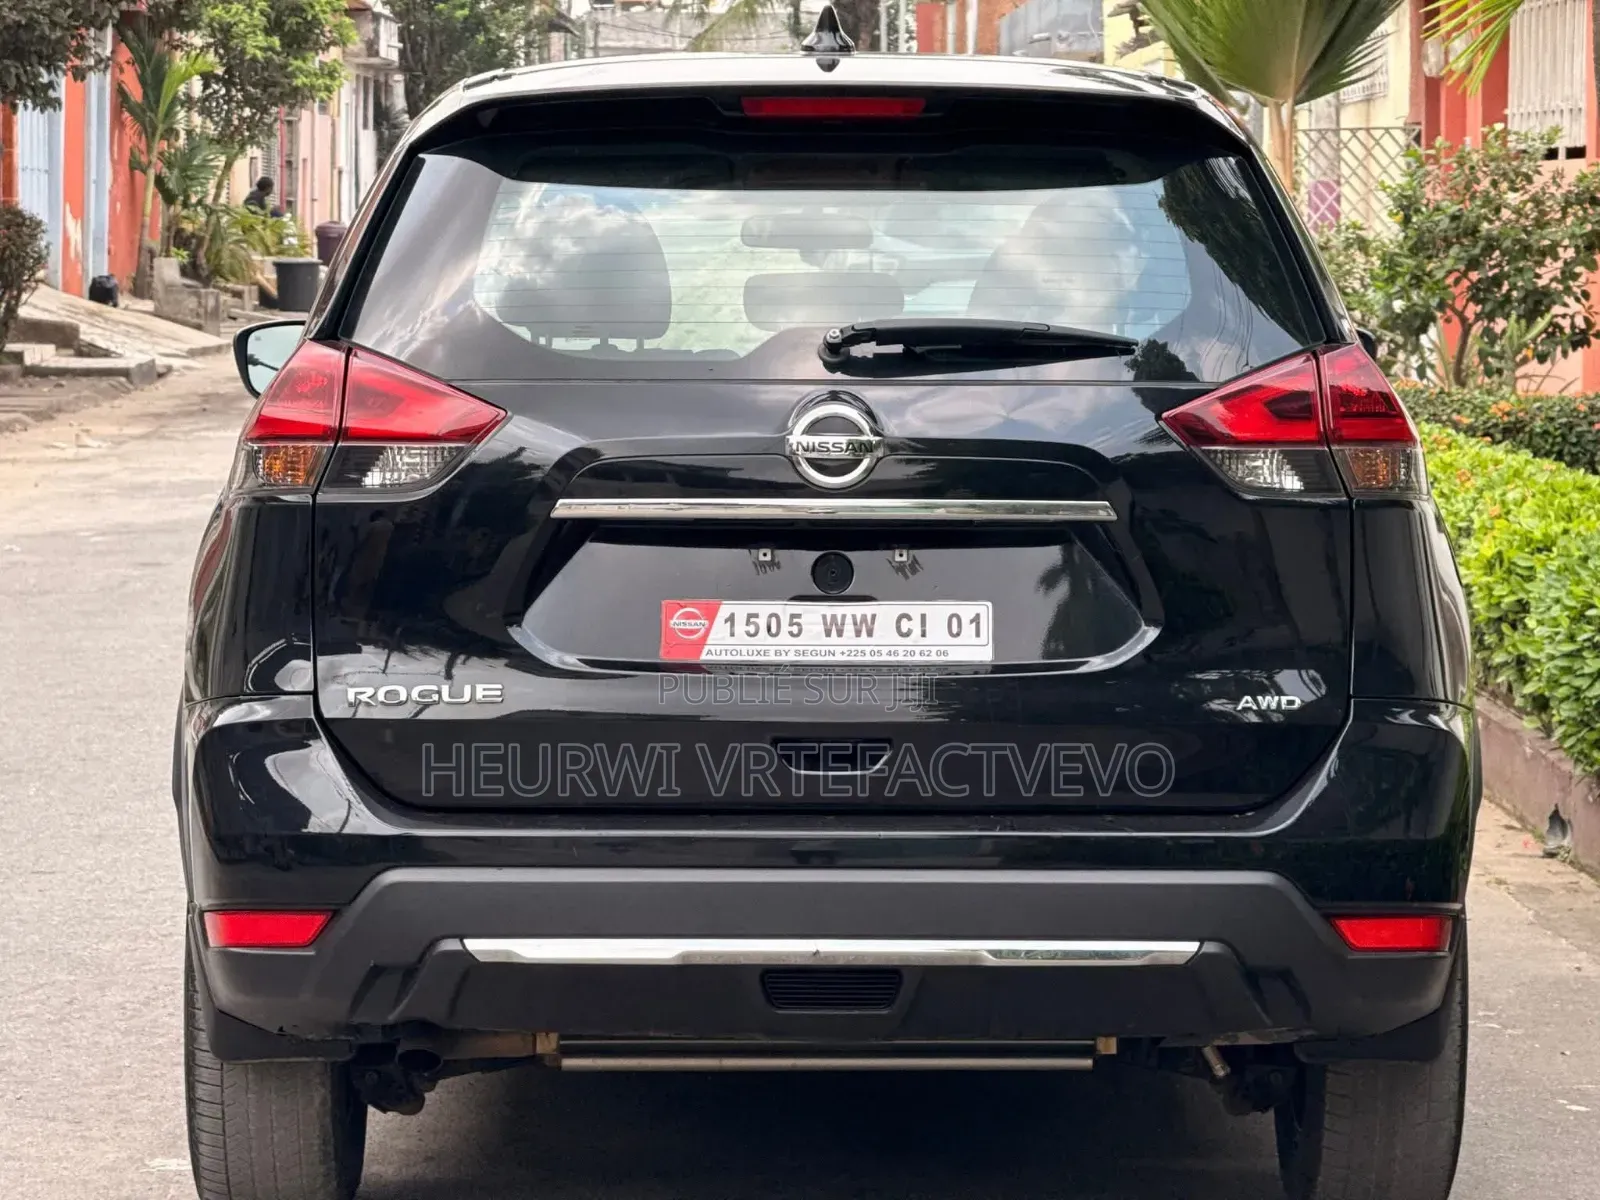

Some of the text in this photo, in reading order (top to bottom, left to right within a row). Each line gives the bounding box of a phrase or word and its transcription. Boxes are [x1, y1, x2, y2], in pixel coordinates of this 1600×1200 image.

[795, 441, 874, 453] NISSAN
[672, 620, 706, 629] NISSAN
[723, 612, 981, 638] 1505 WW CI 01
[705, 649, 949, 657] AUTOLUXE BY SEGUN +225 05 46 20 62 06
[347, 684, 504, 706] ROGUE
[1236, 695, 1302, 711] AWD
